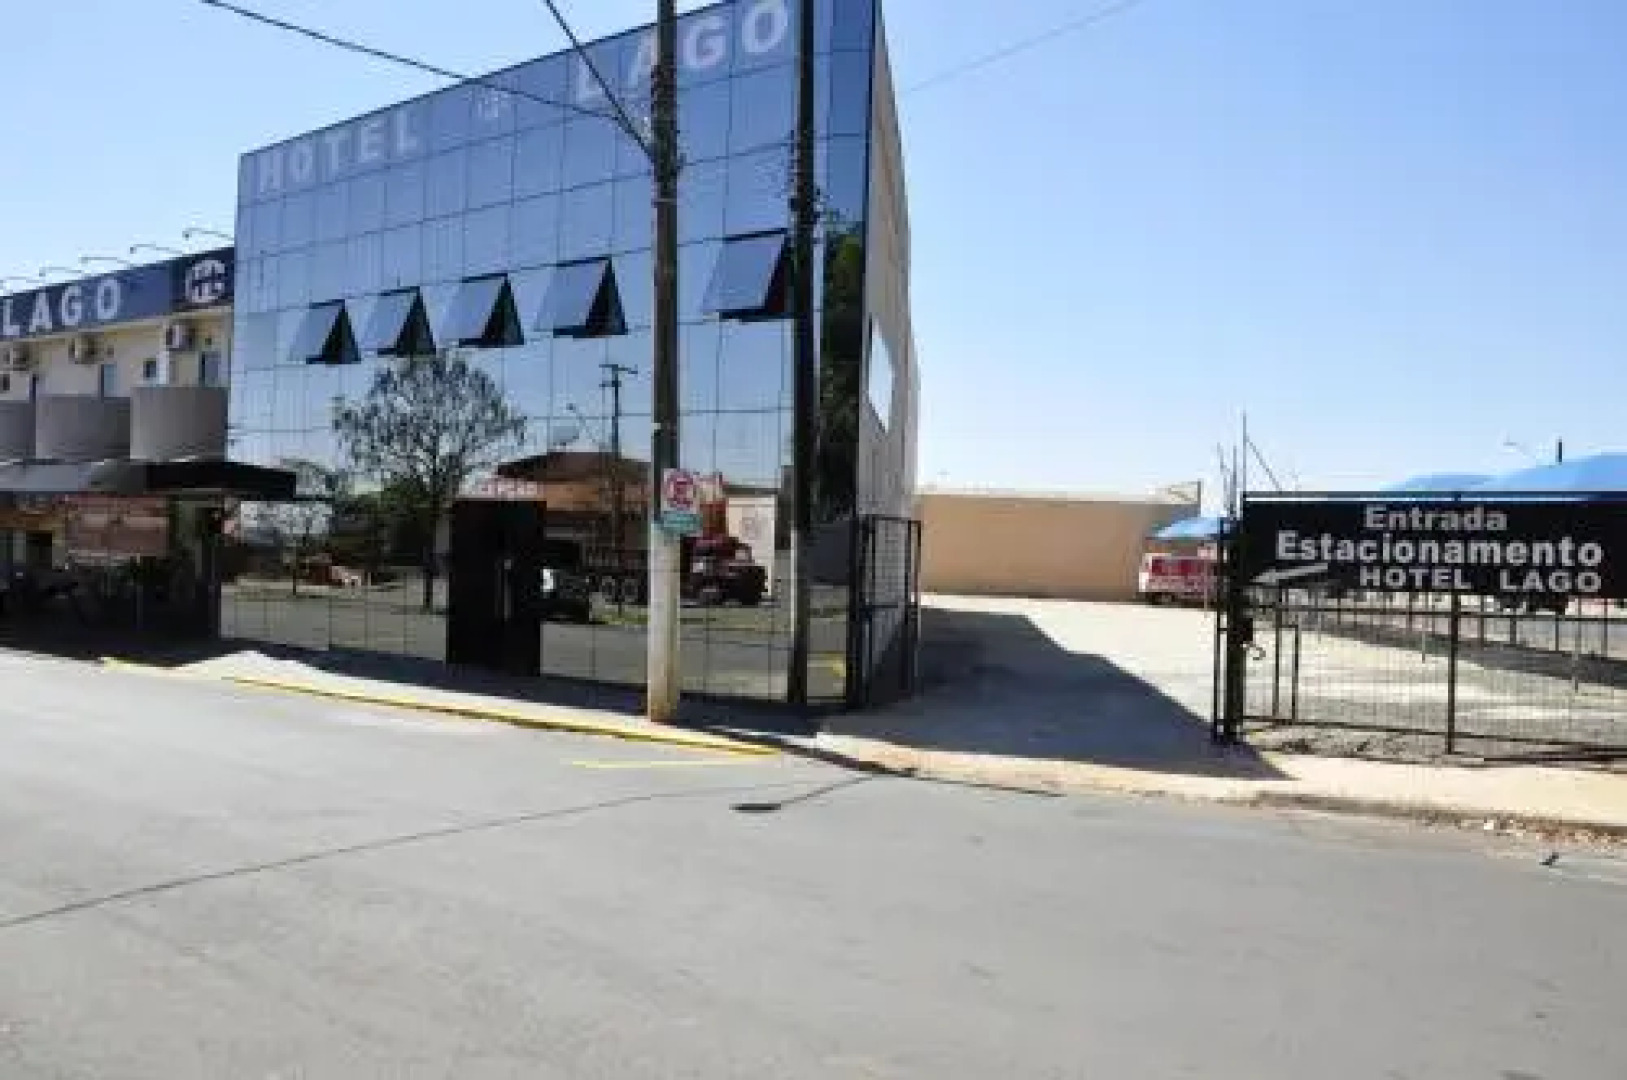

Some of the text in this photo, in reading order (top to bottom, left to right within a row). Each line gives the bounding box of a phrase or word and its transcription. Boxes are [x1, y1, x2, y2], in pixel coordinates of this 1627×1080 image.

[259, 0, 789, 194] HOTEL LAGO
[2, 278, 122, 337] LAGO
[1364, 505, 1508, 532] Entrada
[1276, 530, 1603, 567] Estacionamento
[1359, 565, 1602, 592] HOTEL LAGO
